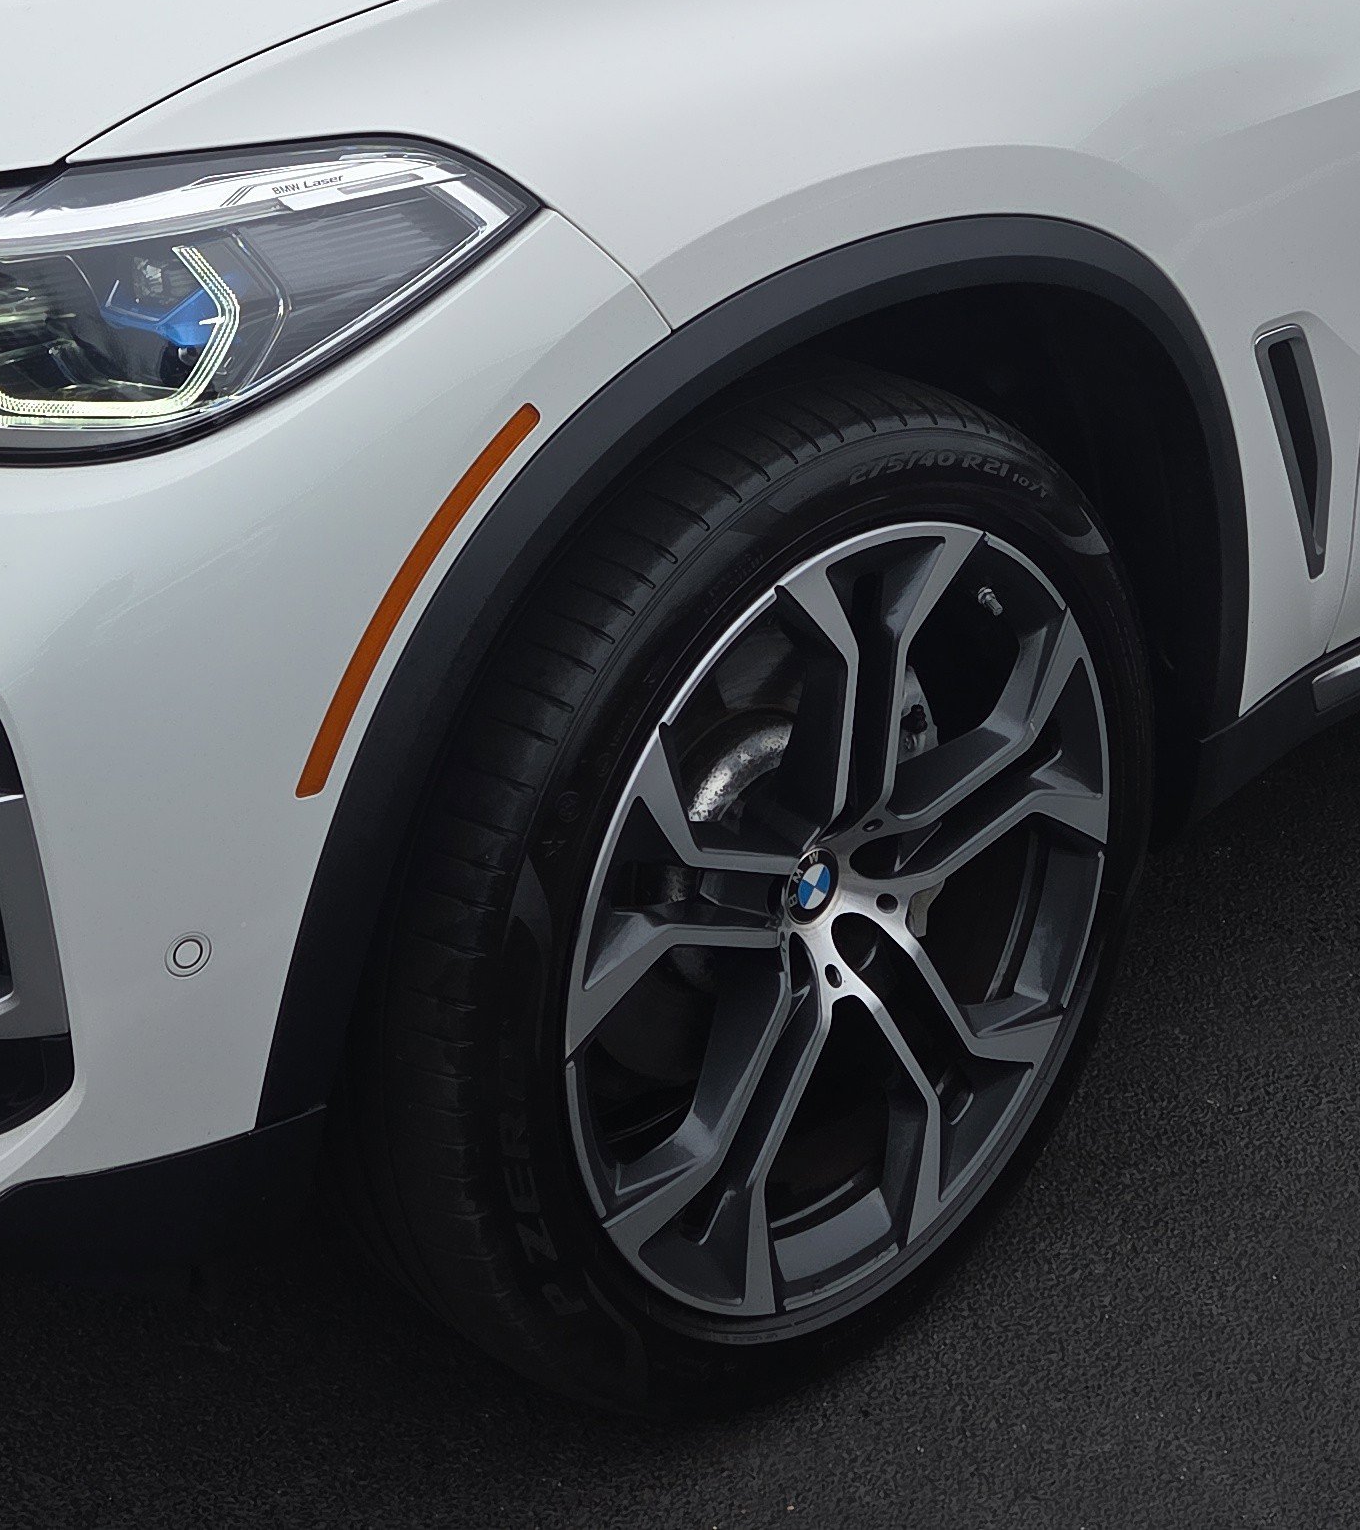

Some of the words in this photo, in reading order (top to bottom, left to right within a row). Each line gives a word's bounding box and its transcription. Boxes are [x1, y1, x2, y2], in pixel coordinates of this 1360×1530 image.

[271, 182, 300, 195] BMW
[303, 174, 344, 189] Laser
[848, 448, 958, 486] 275/40
[961, 454, 1010, 478] R21
[788, 850, 819, 908] BMW
